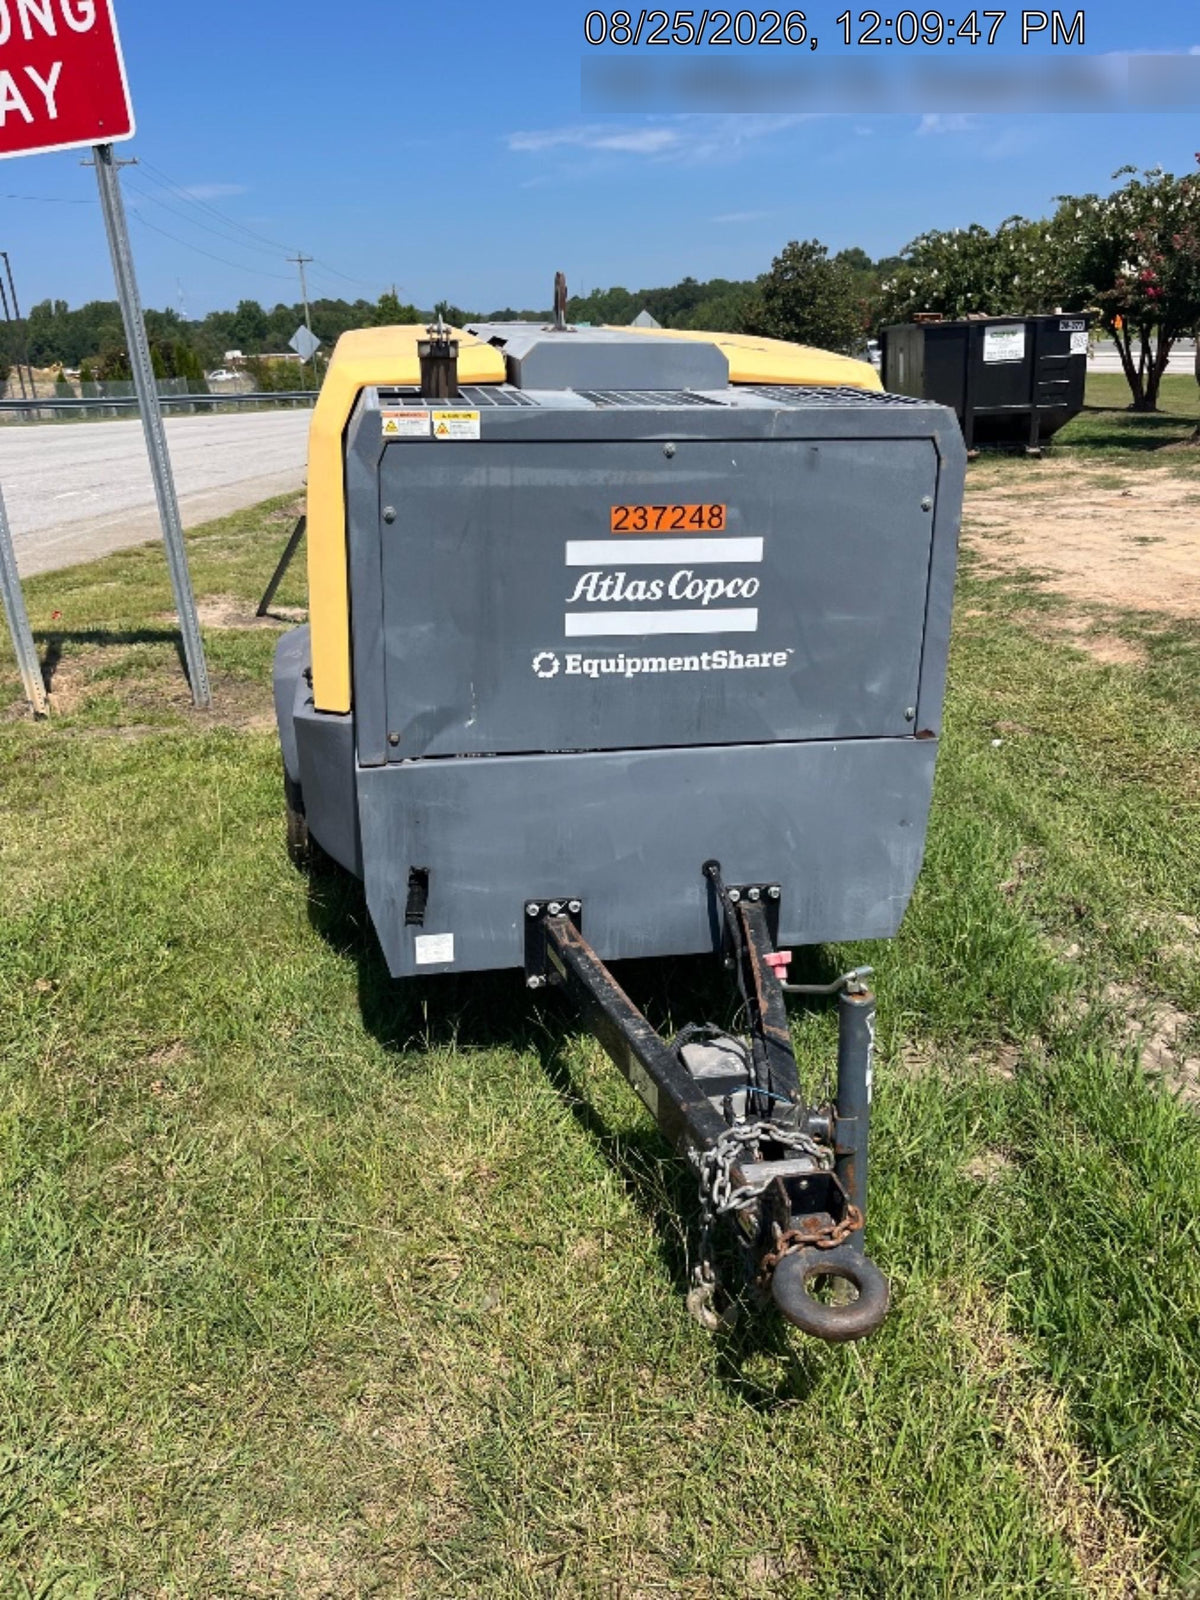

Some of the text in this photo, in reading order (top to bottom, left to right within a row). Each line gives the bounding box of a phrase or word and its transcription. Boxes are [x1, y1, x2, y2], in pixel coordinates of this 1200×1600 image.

[613, 504, 724, 531] 237248
[565, 570, 760, 605] Atlas Copco
[564, 650, 788, 678] EquipmentShare
